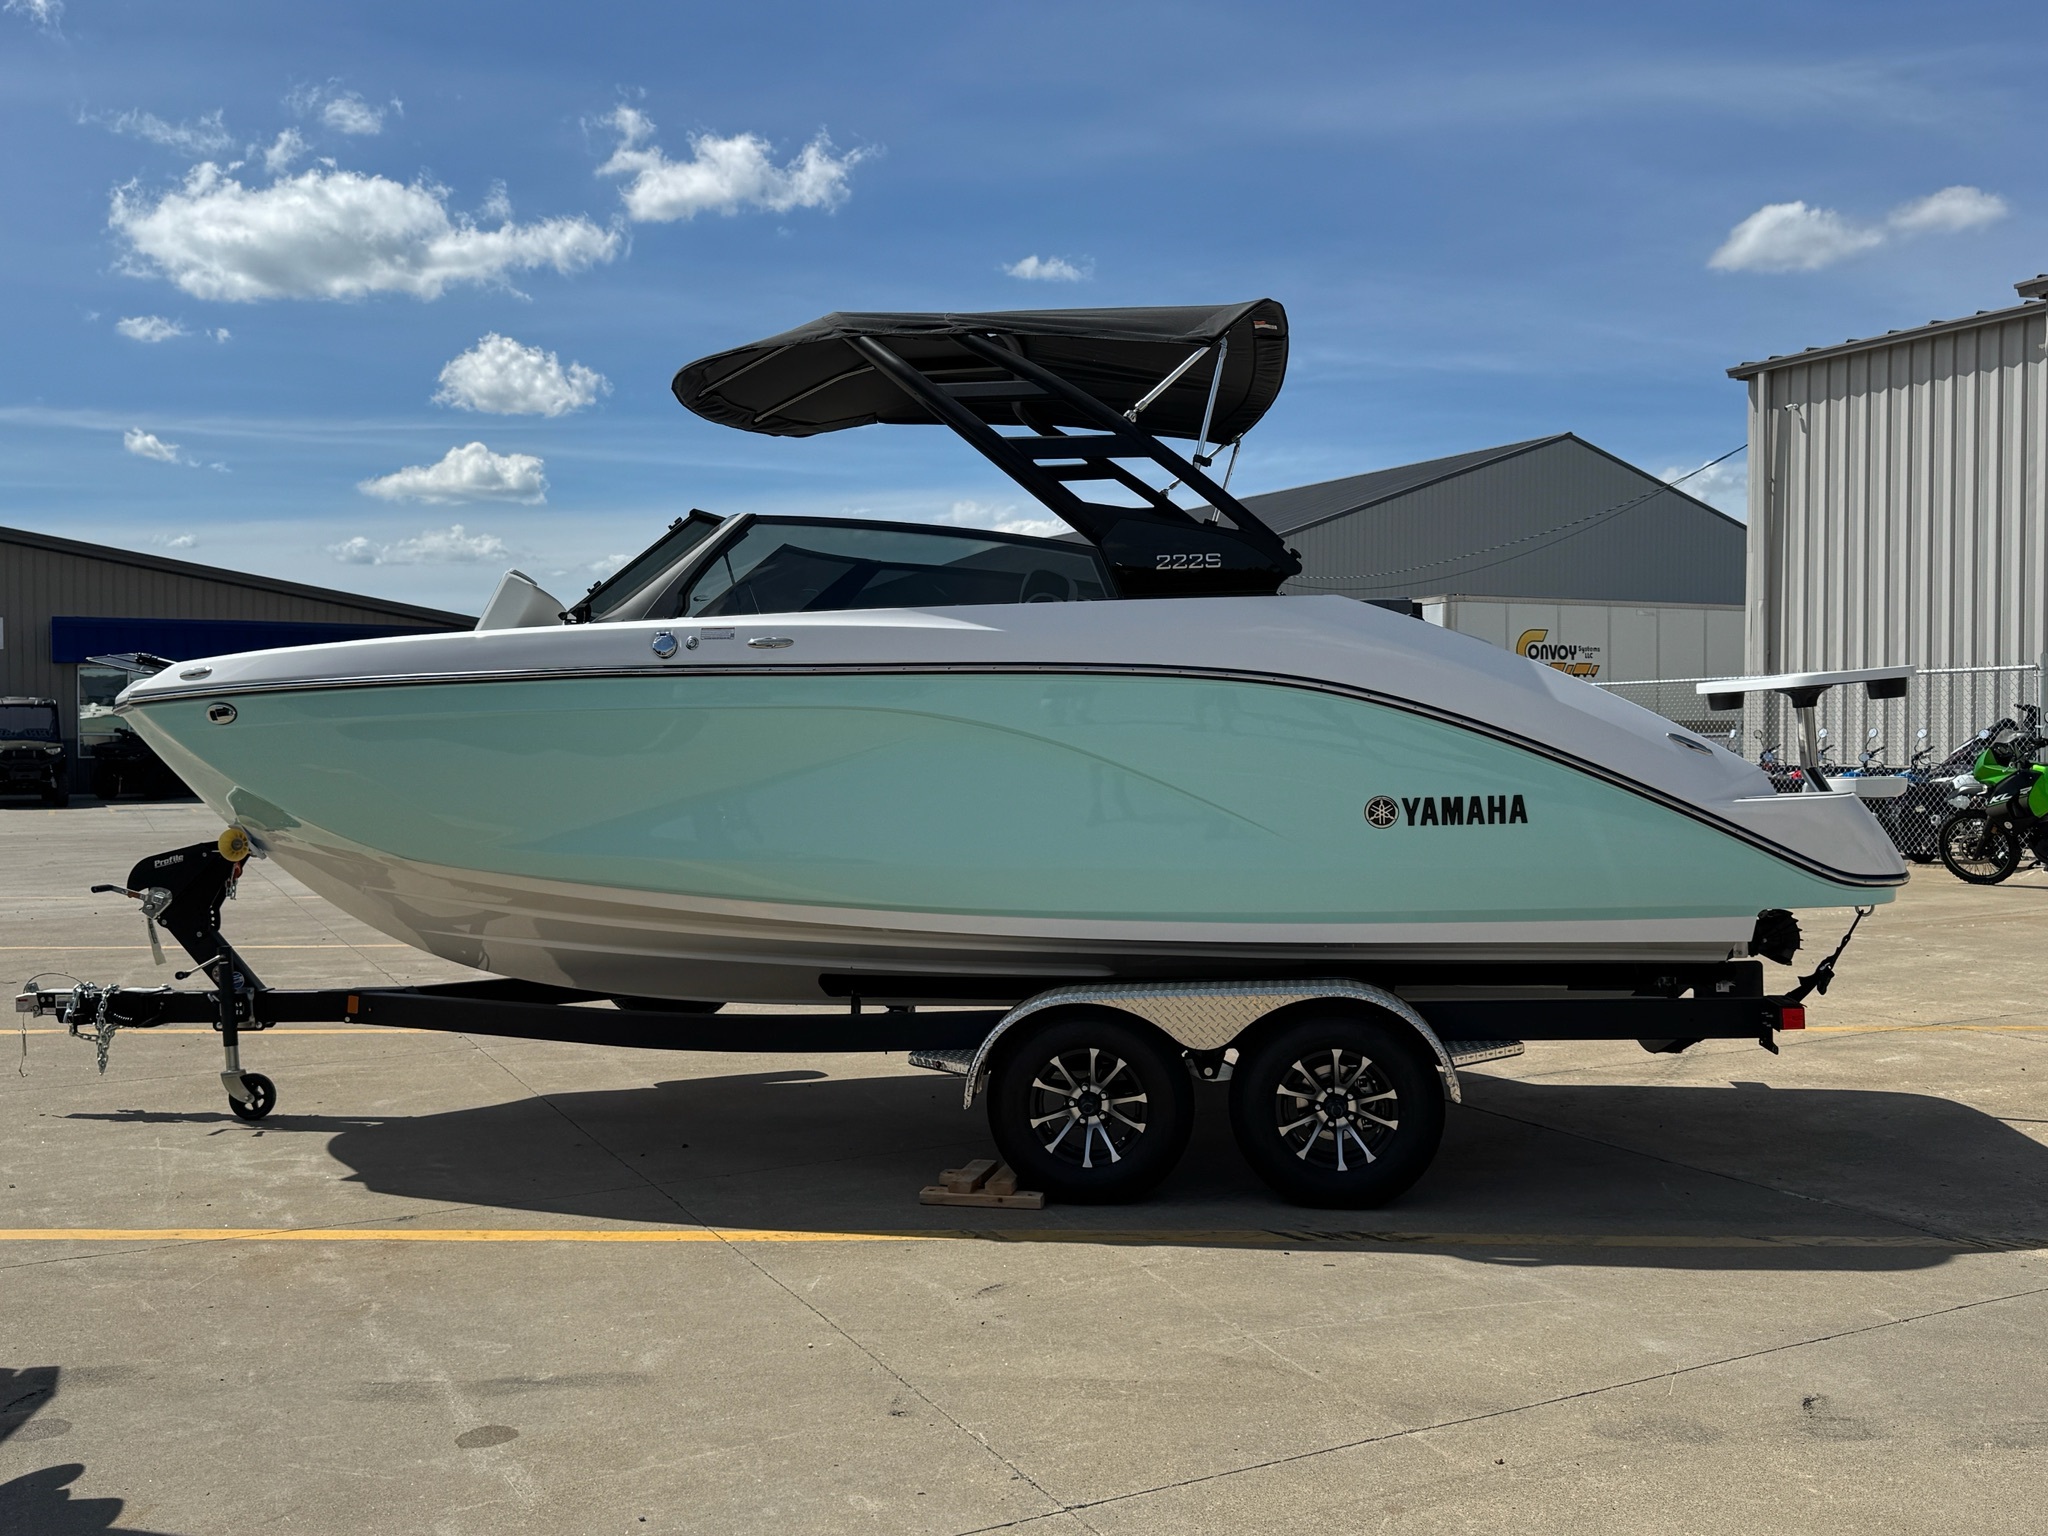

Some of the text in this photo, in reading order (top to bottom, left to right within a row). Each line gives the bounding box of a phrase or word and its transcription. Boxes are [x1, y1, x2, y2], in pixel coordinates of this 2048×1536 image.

[1156, 553, 1221, 570] 222S
[1401, 794, 1528, 826] YAMAHA
[154, 854, 184, 869] Profile
